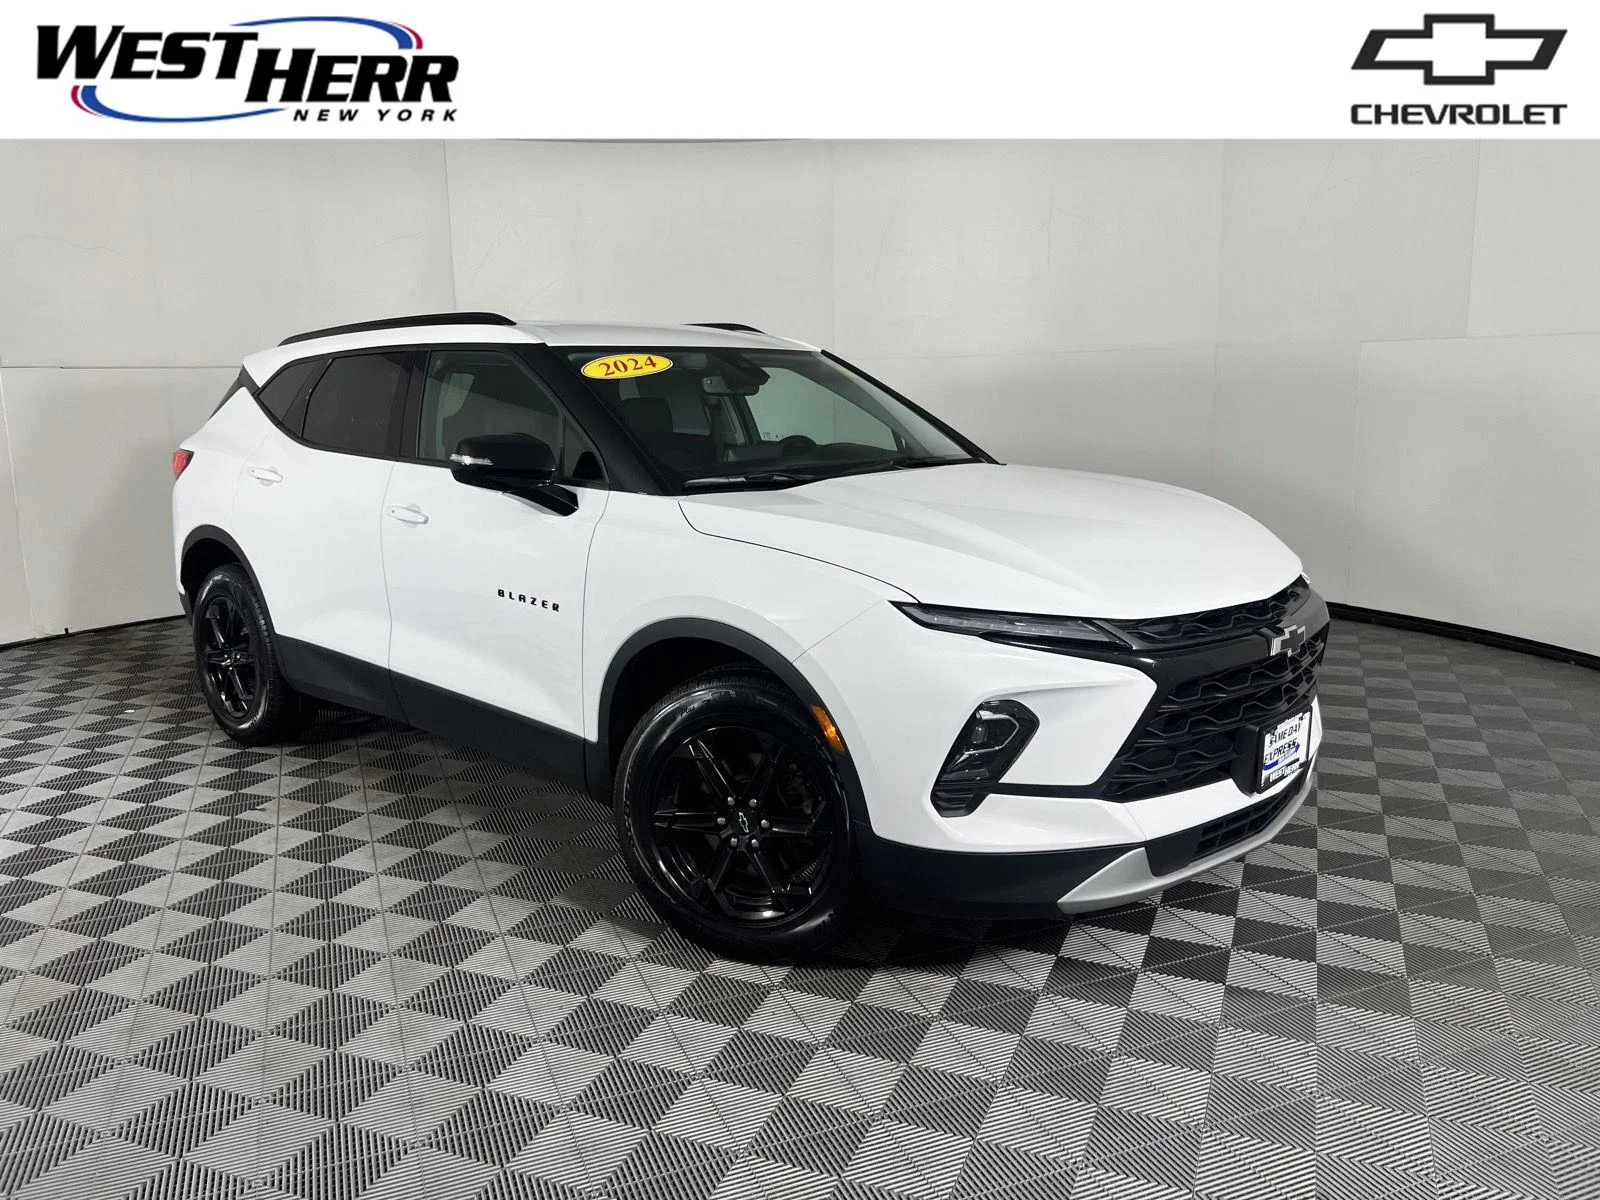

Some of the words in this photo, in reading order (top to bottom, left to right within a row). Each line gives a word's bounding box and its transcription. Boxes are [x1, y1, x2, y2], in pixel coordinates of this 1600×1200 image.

[599, 356, 656, 376] 2024
[497, 588, 560, 613] BLAZER
[1268, 729, 1287, 748] SAME
[1287, 723, 1302, 736] DAY
[1264, 738, 1298, 764] EXPRESS
